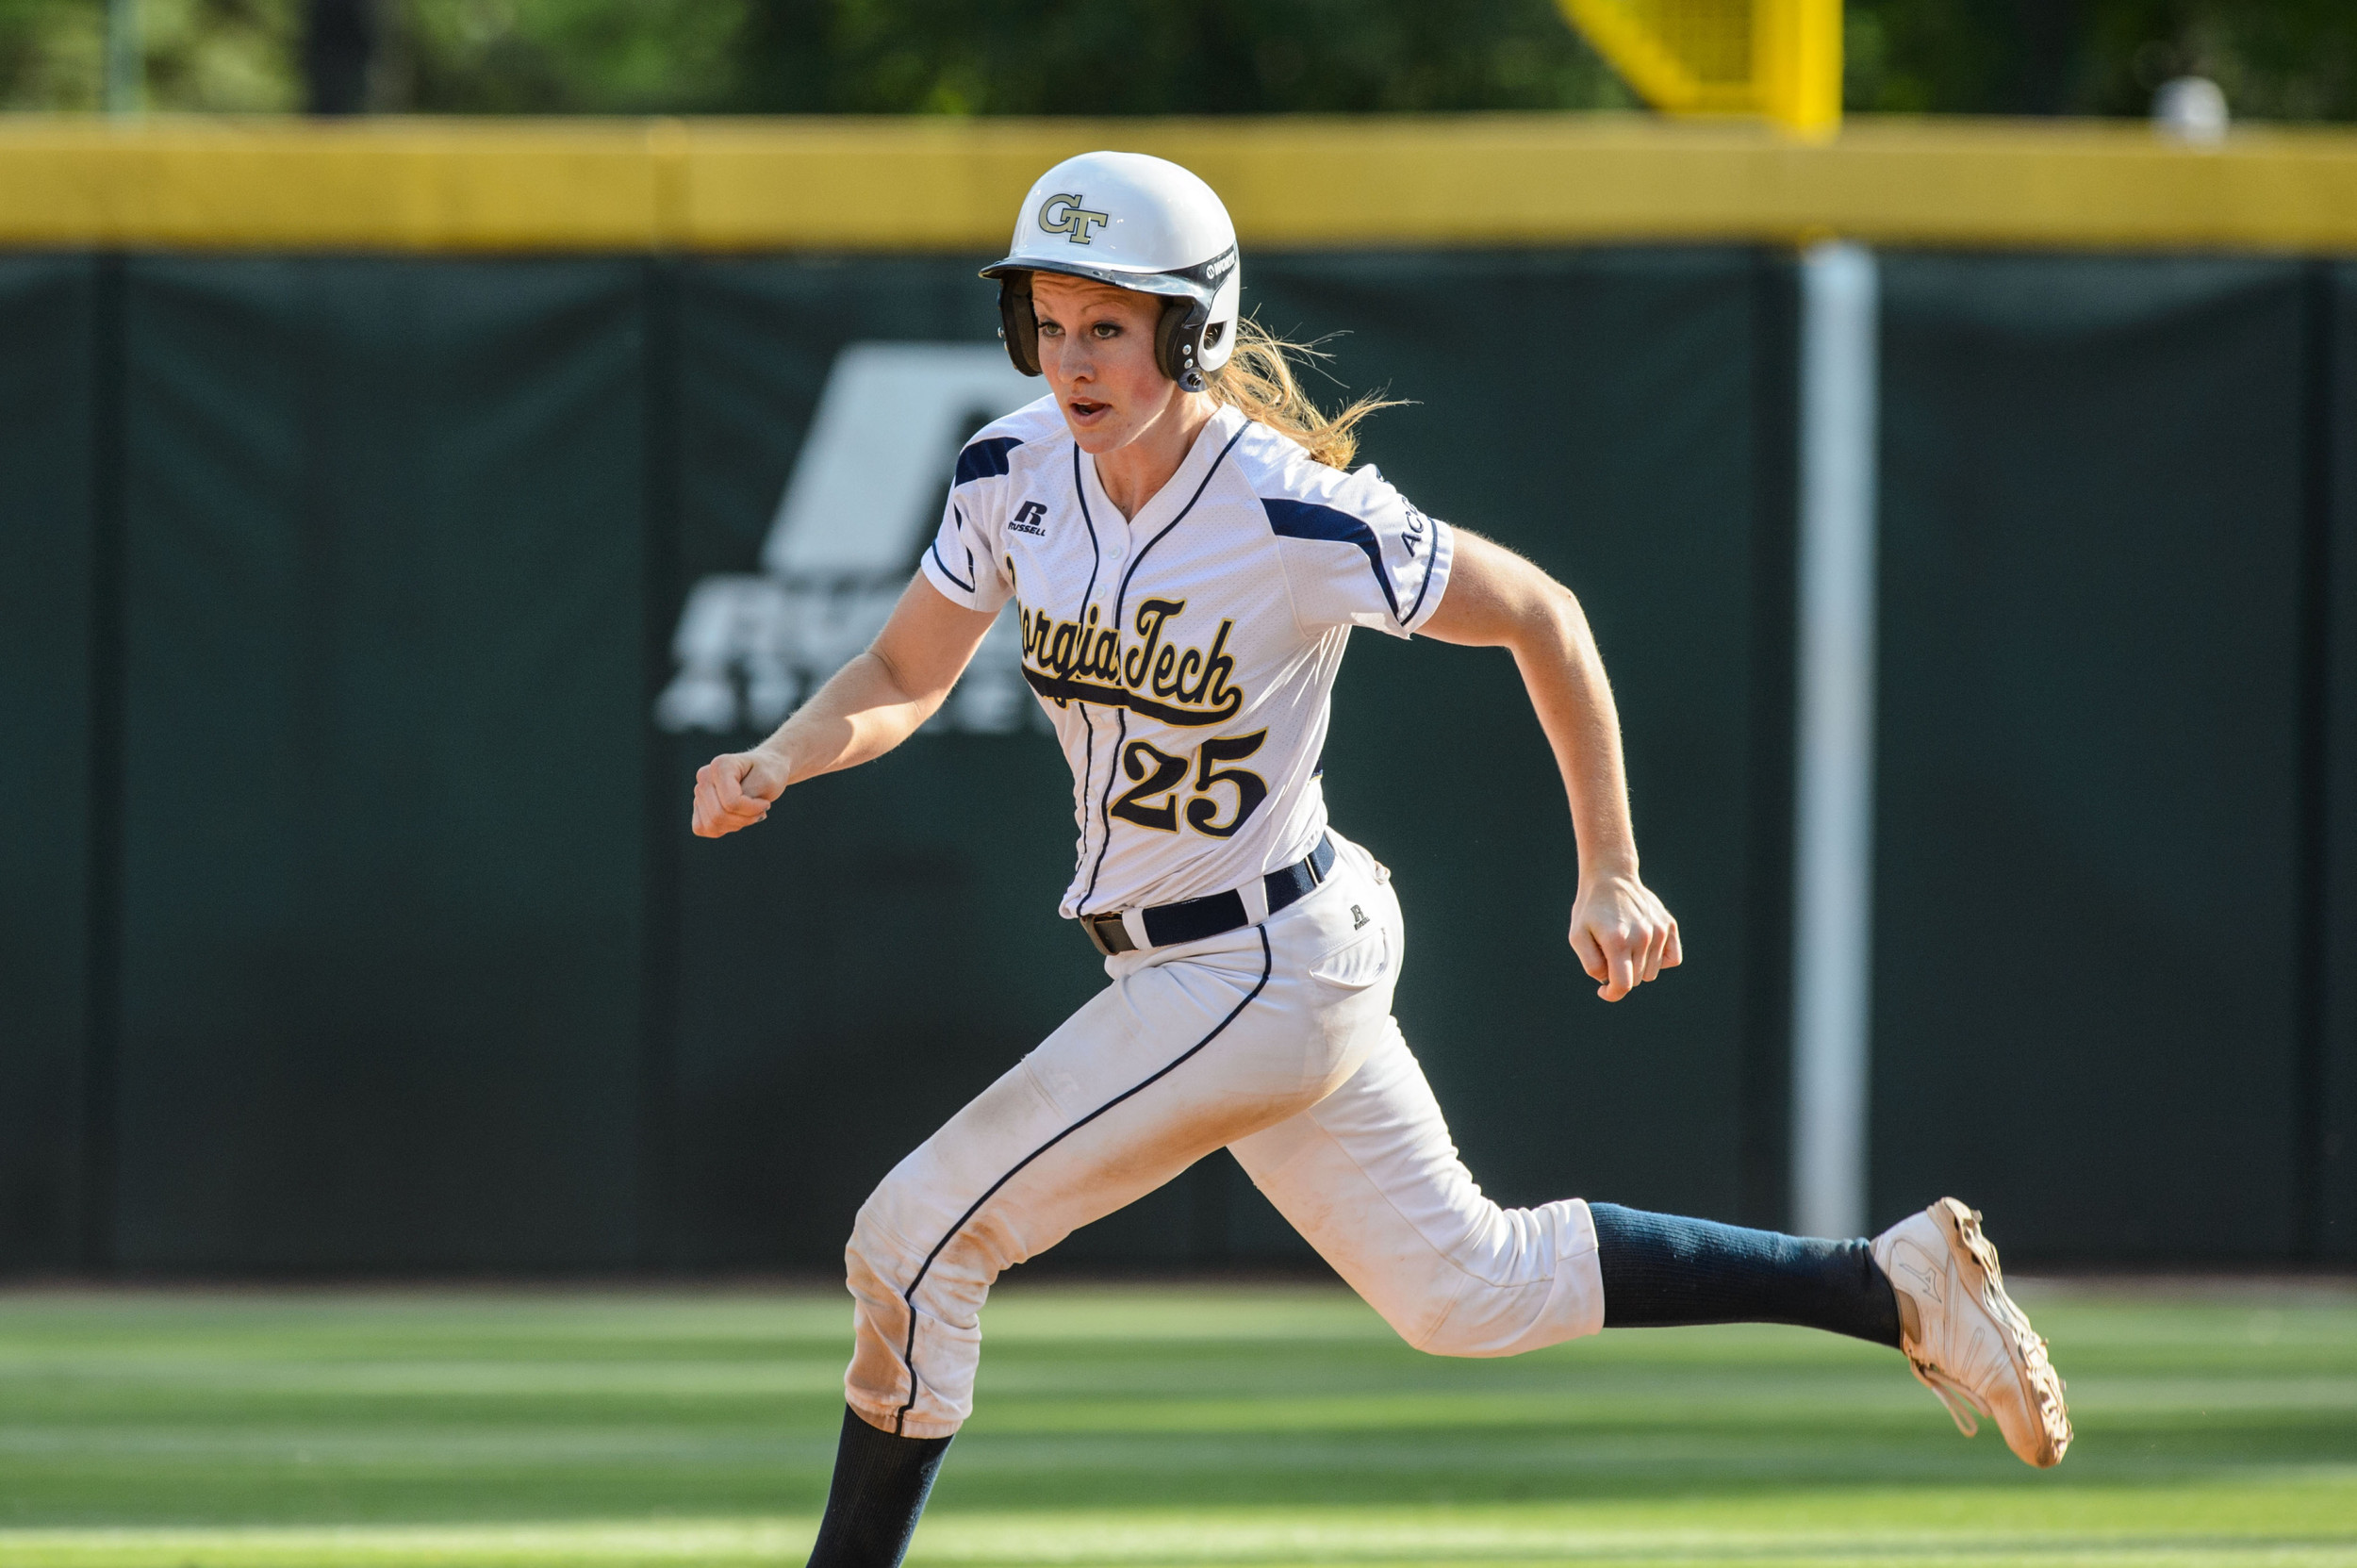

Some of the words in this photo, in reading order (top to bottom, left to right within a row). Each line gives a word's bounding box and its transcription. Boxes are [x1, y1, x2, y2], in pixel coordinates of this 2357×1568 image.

[1038, 193, 1109, 245] GT
[1008, 520, 1046, 536] RUSSELL
[1014, 500, 1047, 526] R
[1125, 597, 1244, 707] Tech
[1111, 727, 1269, 840] 25
